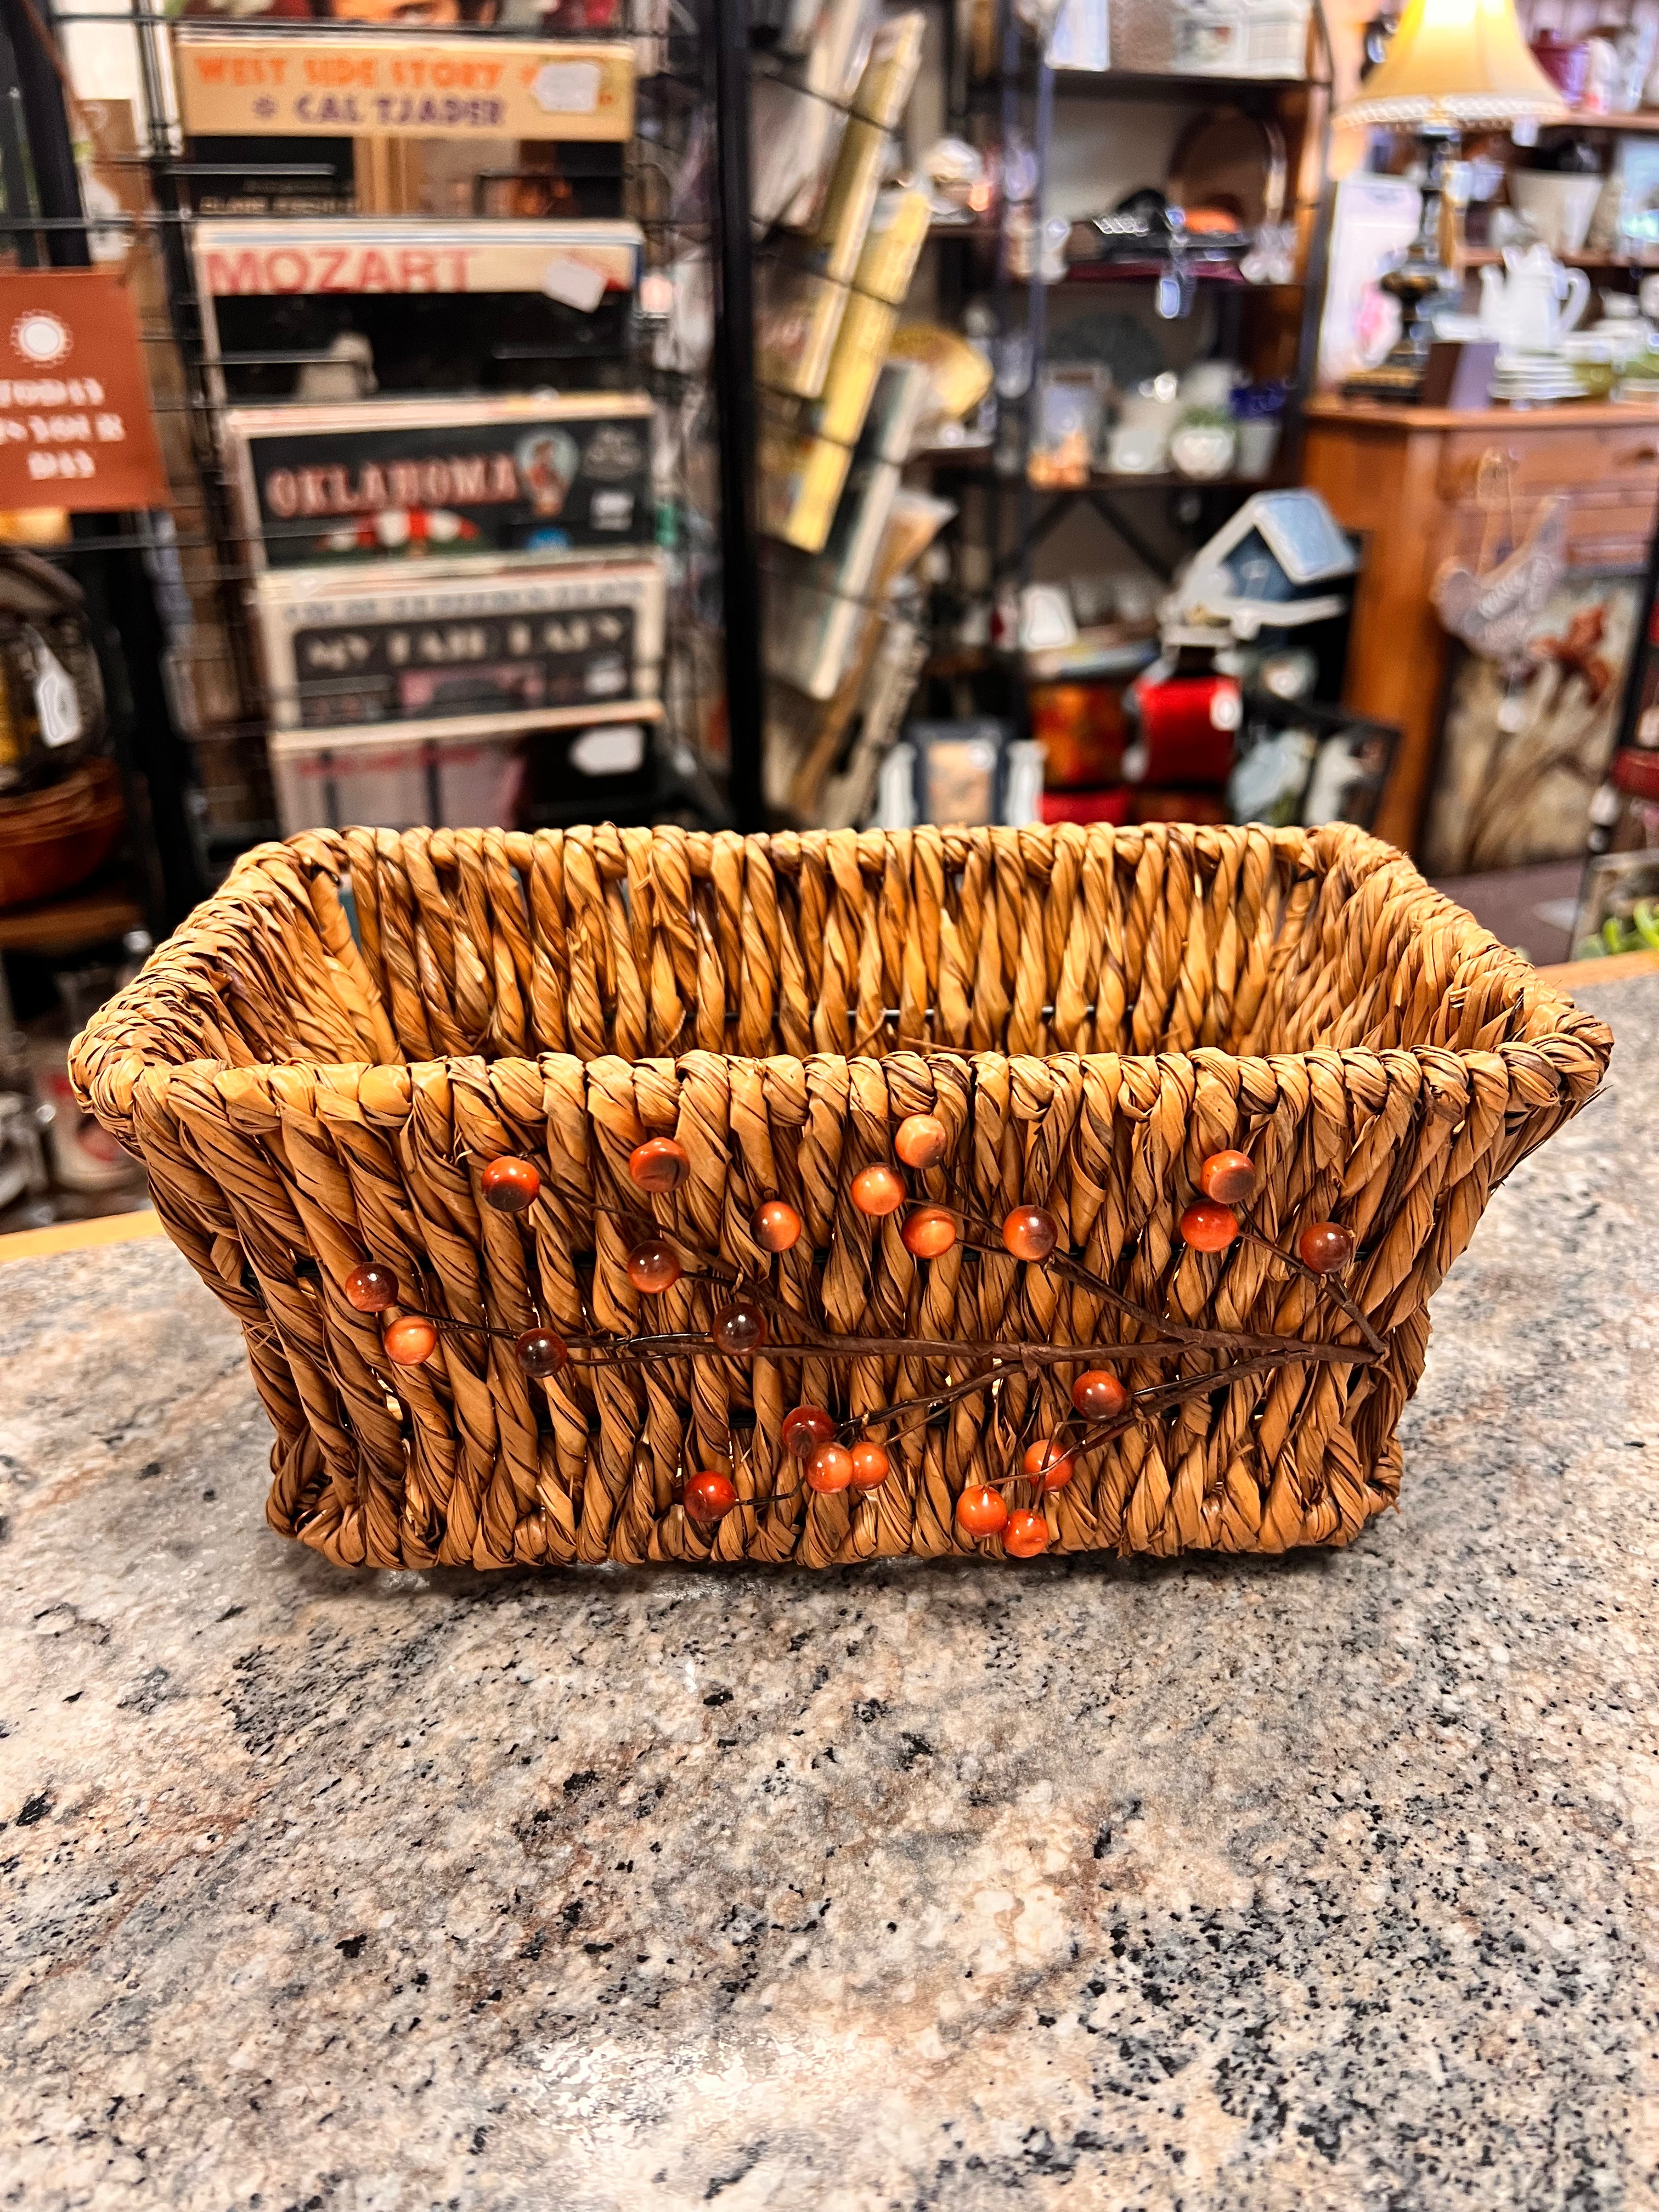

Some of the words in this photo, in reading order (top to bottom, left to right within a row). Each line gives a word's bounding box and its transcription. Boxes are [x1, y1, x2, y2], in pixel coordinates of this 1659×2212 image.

[195, 57, 286, 85] WEST
[303, 57, 379, 86] SIDE
[392, 59, 504, 88] STORY
[294, 94, 362, 124] CAL
[377, 98, 506, 126] TJADER
[205, 248, 473, 295] MOZART
